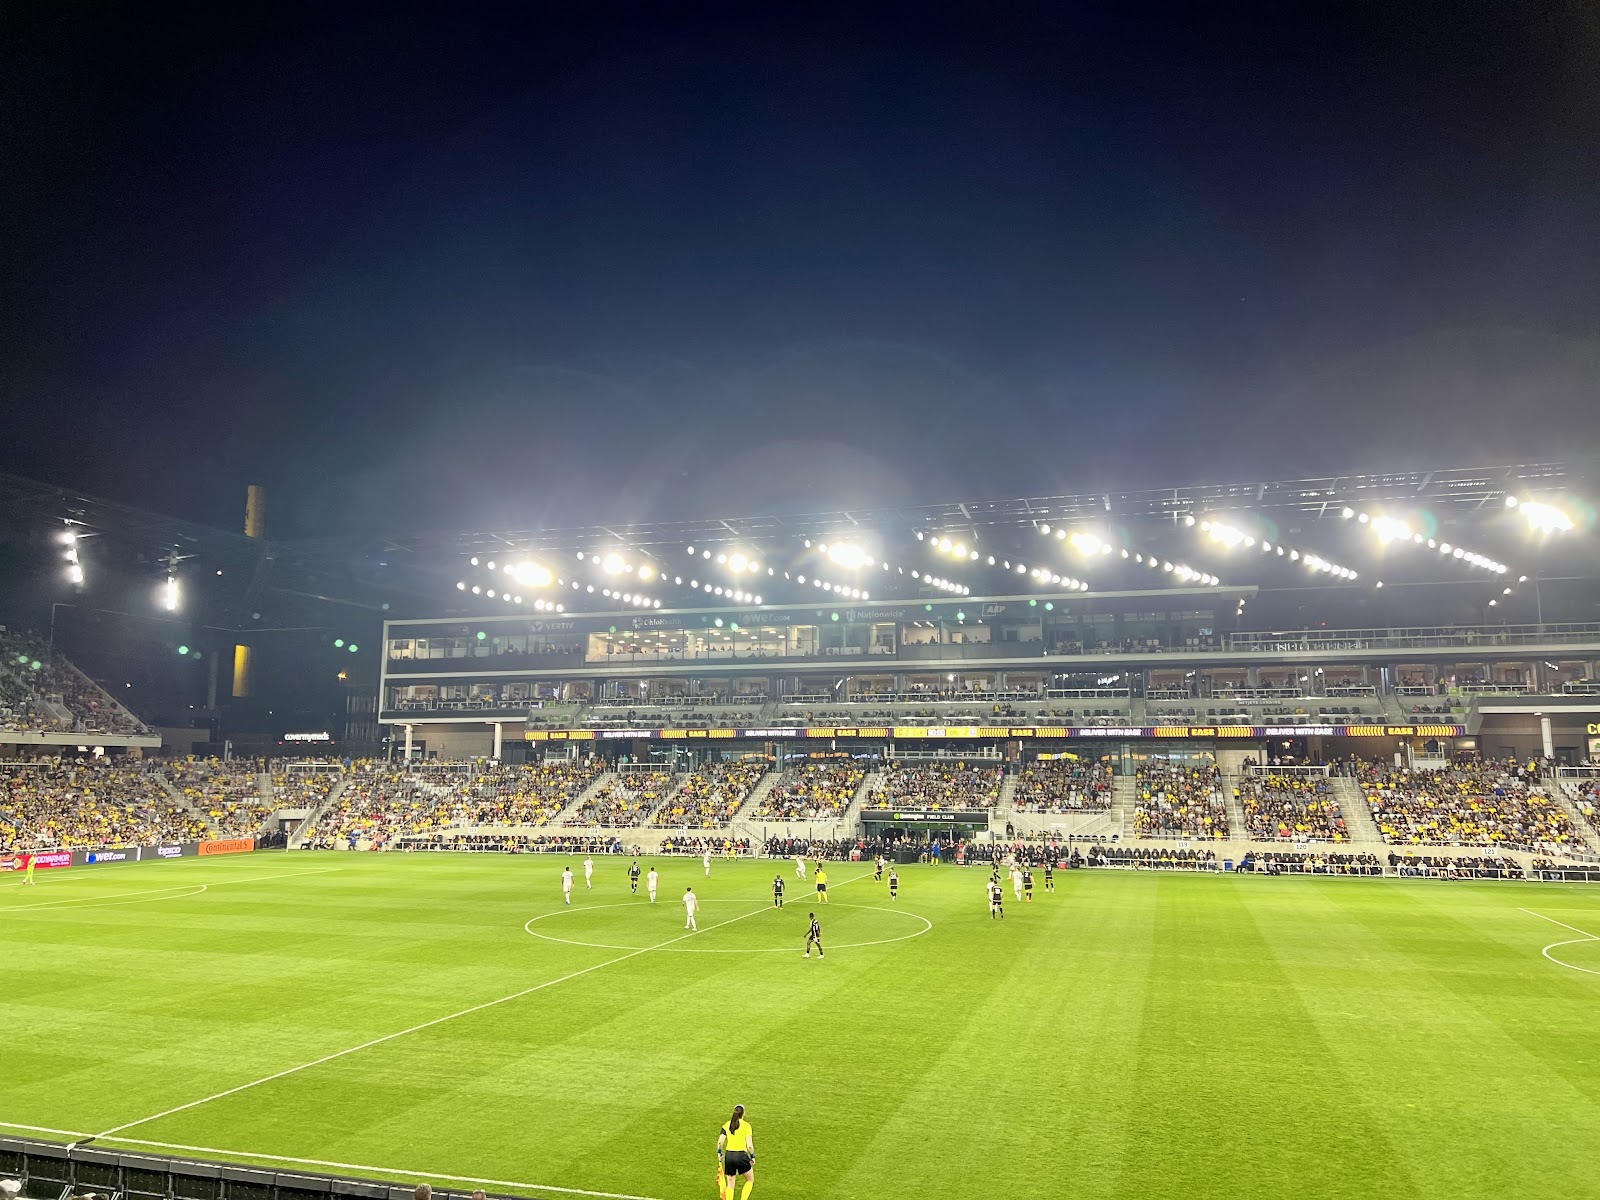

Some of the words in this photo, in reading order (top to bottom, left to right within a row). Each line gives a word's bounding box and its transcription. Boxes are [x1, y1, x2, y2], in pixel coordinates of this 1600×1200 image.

[857, 609, 903, 619] Nationwide
[987, 605, 1006, 614] AEP
[643, 616, 682, 626] OhioHealth
[545, 622, 575, 631] VERTIV
[1191, 728, 1215, 736] EASE
[1387, 727, 1414, 735] EASE
[284, 731, 330, 742] covermymeds
[206, 840, 243, 854] Continental
